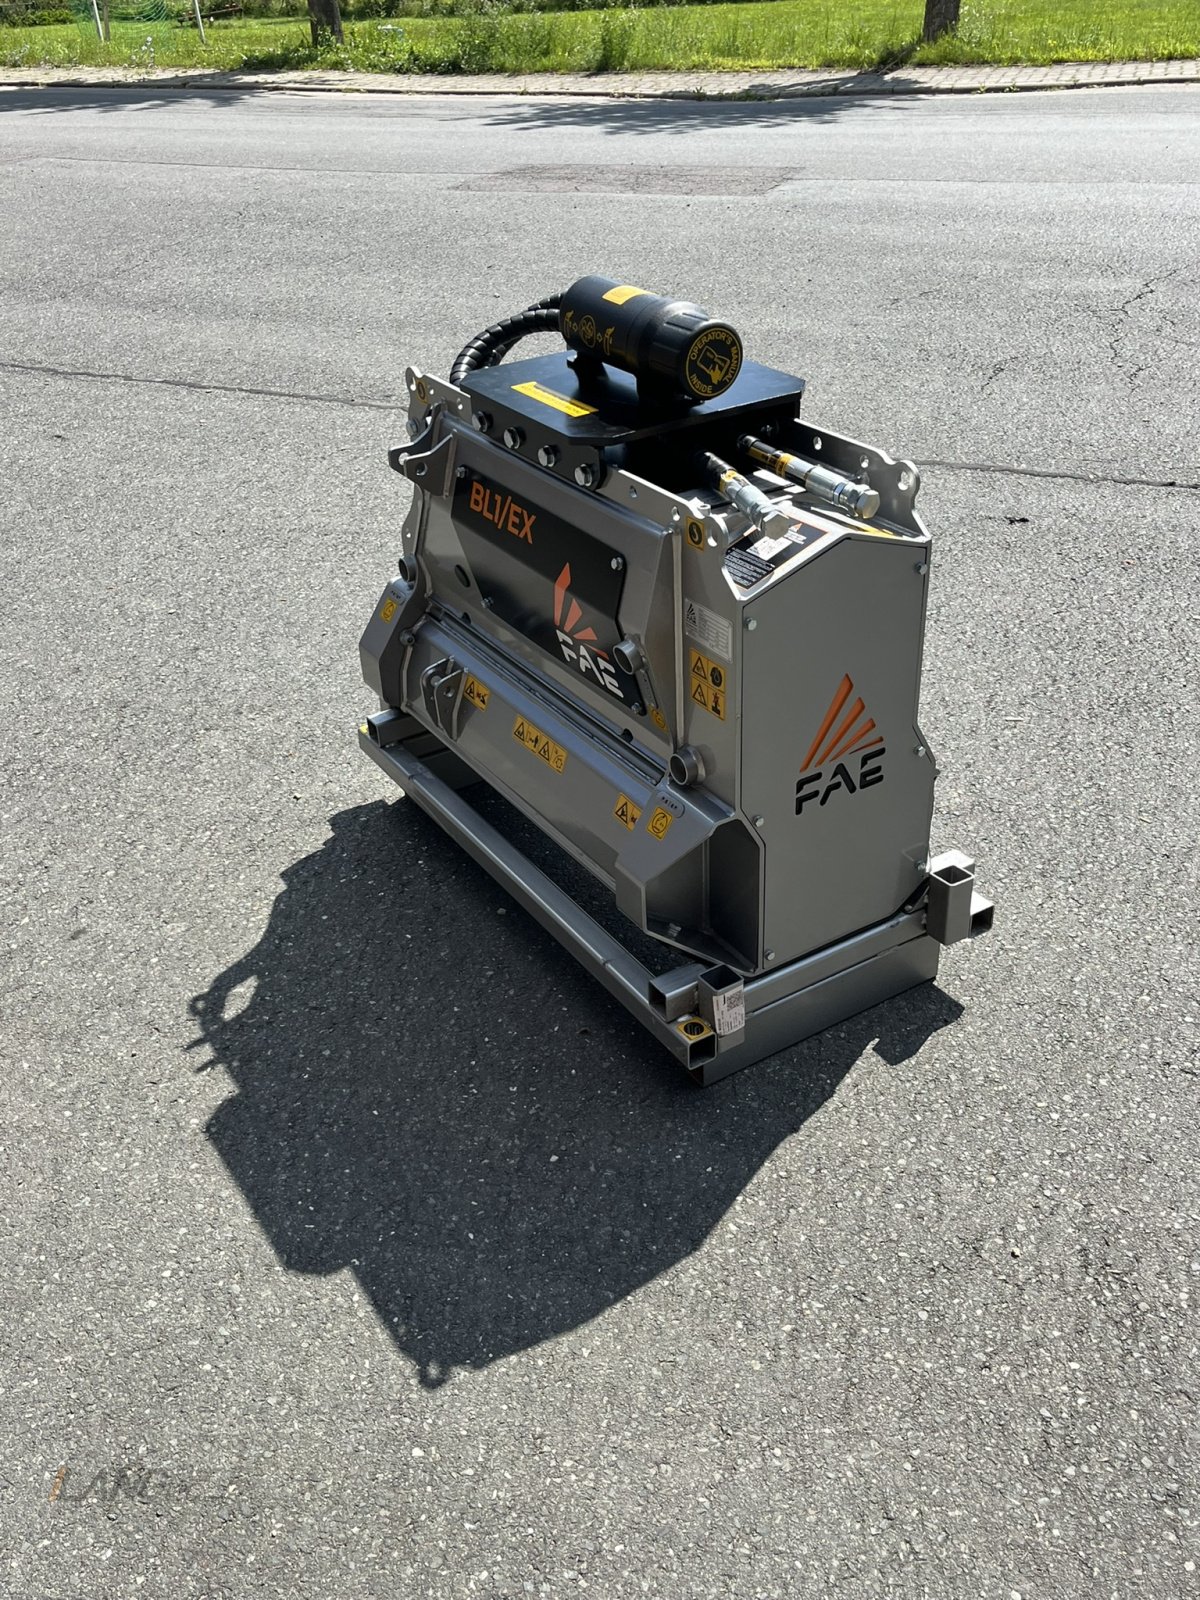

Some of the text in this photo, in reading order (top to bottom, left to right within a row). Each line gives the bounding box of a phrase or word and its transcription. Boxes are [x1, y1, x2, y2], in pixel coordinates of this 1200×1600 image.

[690, 331, 739, 383] OPERATOR'S MANUAL
[690, 373, 713, 394] INSIDE
[469, 481, 537, 544] BL1/EX
[555, 629, 624, 699] FAE
[795, 747, 886, 815] FAE
